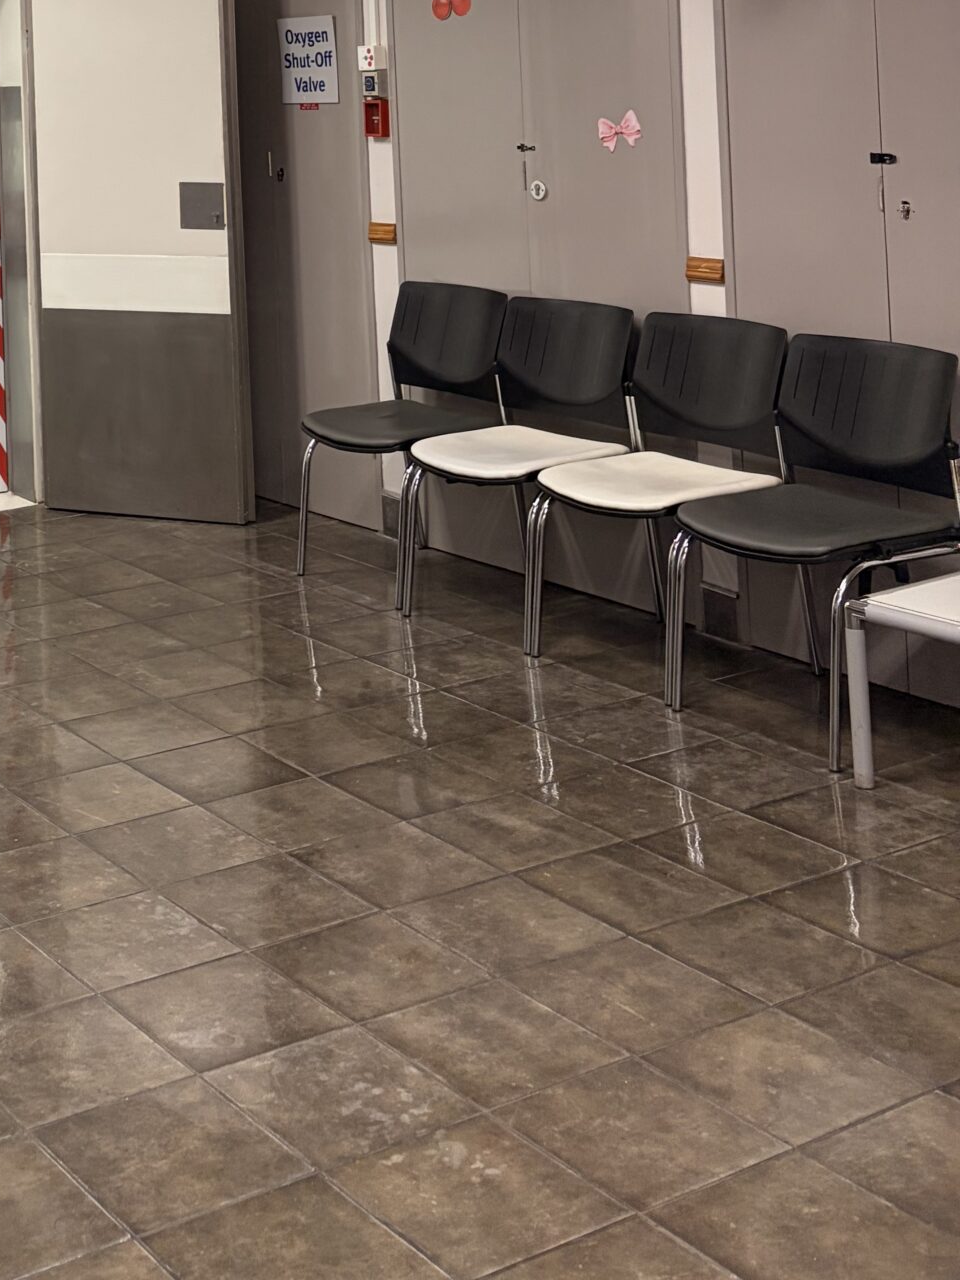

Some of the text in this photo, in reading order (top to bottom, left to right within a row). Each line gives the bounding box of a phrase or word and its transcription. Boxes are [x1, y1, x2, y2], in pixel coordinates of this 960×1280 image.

[285, 29, 329, 48] Oxygen
[284, 51, 333, 69] Shut-Off
[294, 76, 326, 93] Valve
